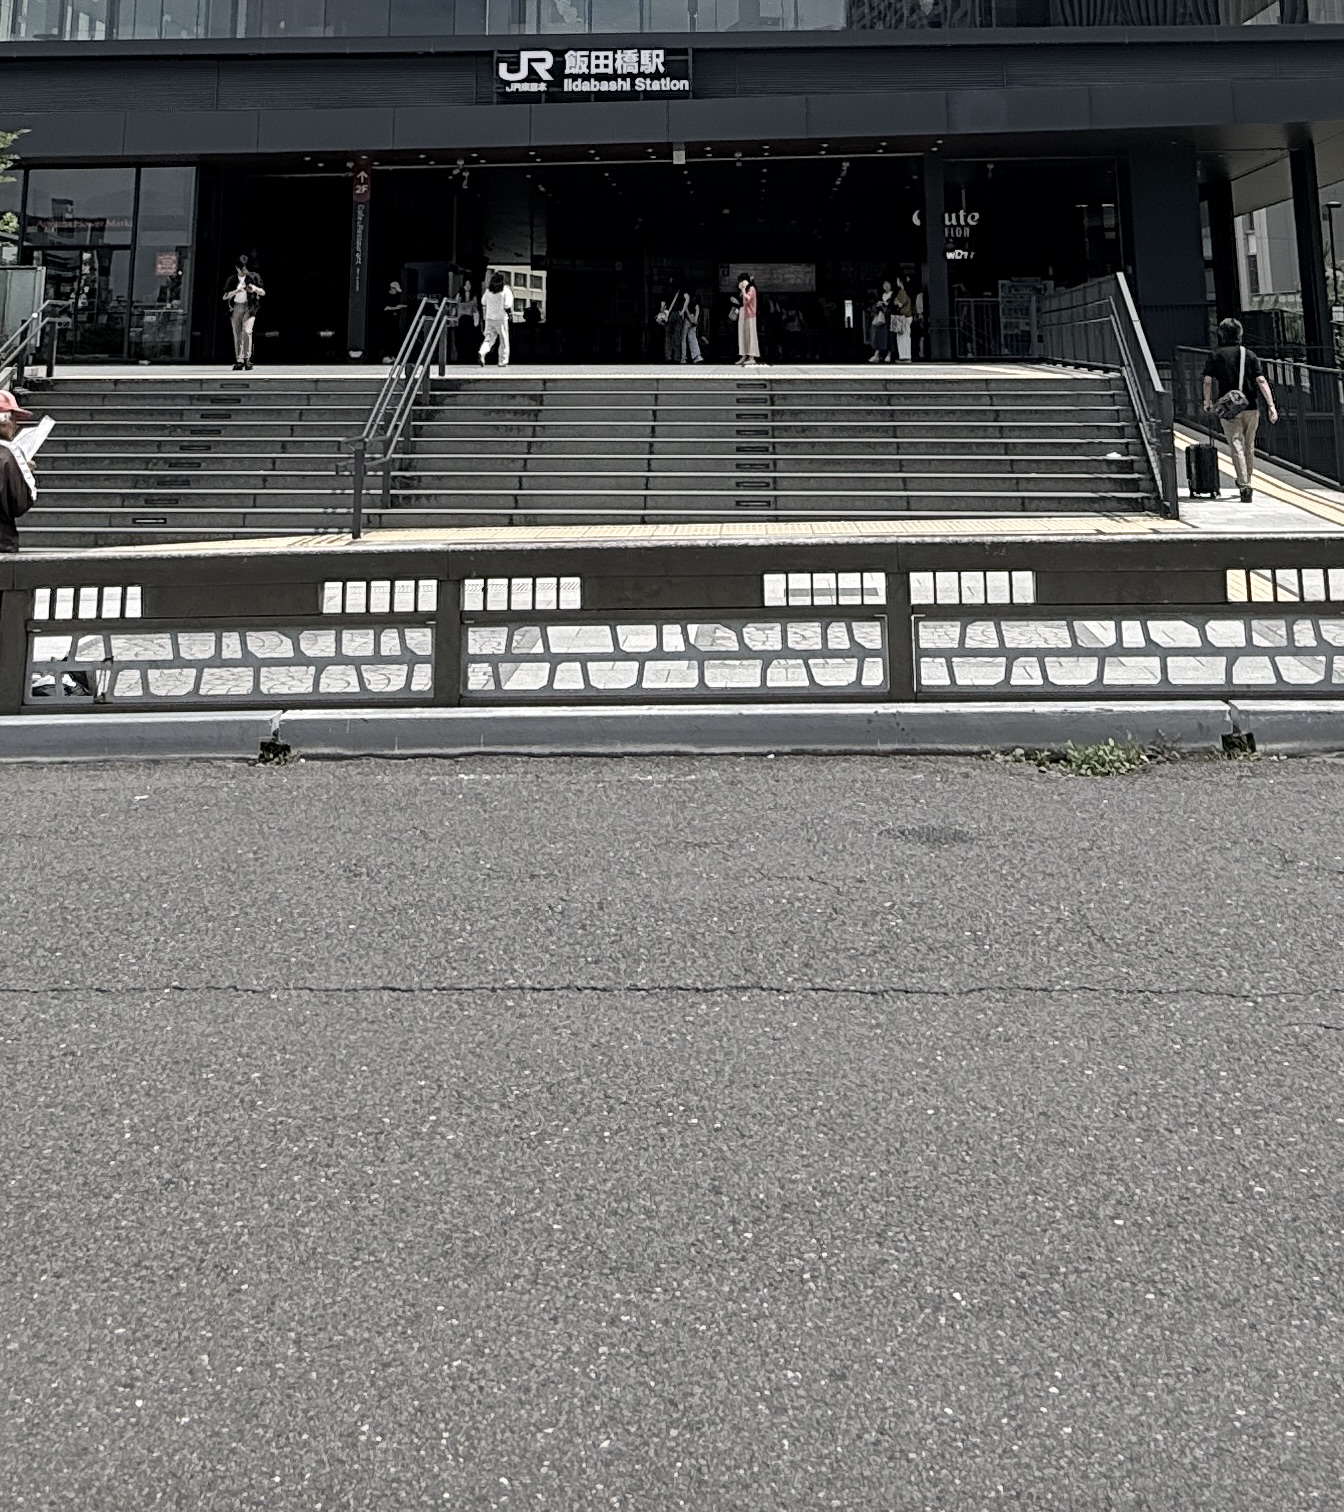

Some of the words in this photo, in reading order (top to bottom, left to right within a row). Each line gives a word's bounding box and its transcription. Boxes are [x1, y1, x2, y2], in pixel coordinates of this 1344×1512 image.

[498, 50, 555, 81] JR
[563, 48, 666, 75] 飯田橋駅
[563, 78, 631, 92] Iidabashi
[634, 77, 690, 92] Station
[355, 184, 369, 195] 2F
